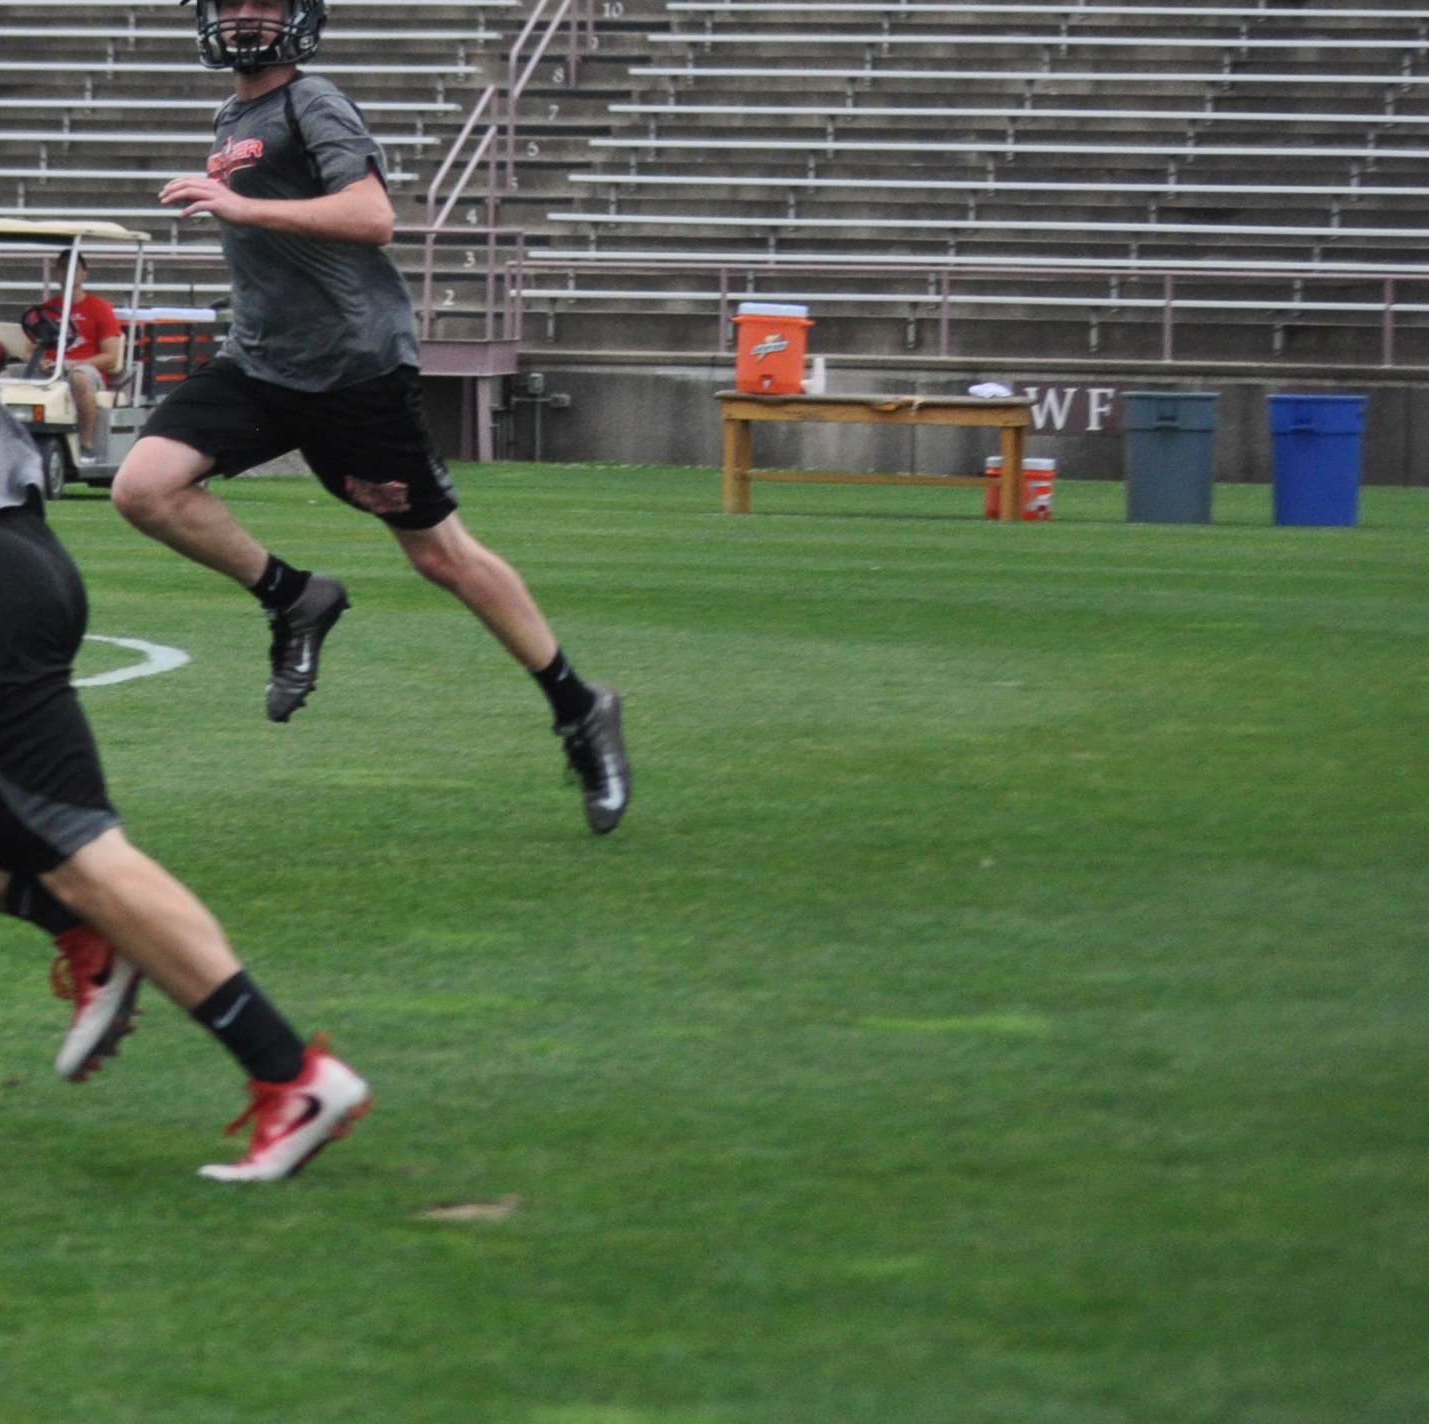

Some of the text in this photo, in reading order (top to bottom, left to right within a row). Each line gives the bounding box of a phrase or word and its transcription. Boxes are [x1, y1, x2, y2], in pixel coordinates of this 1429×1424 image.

[602, 2, 624, 18] 10
[552, 66, 565, 83] 8
[548, 105, 559, 121] 7
[466, 208, 478, 224] 4
[464, 251, 476, 268] 3
[443, 289, 456, 306] 2
